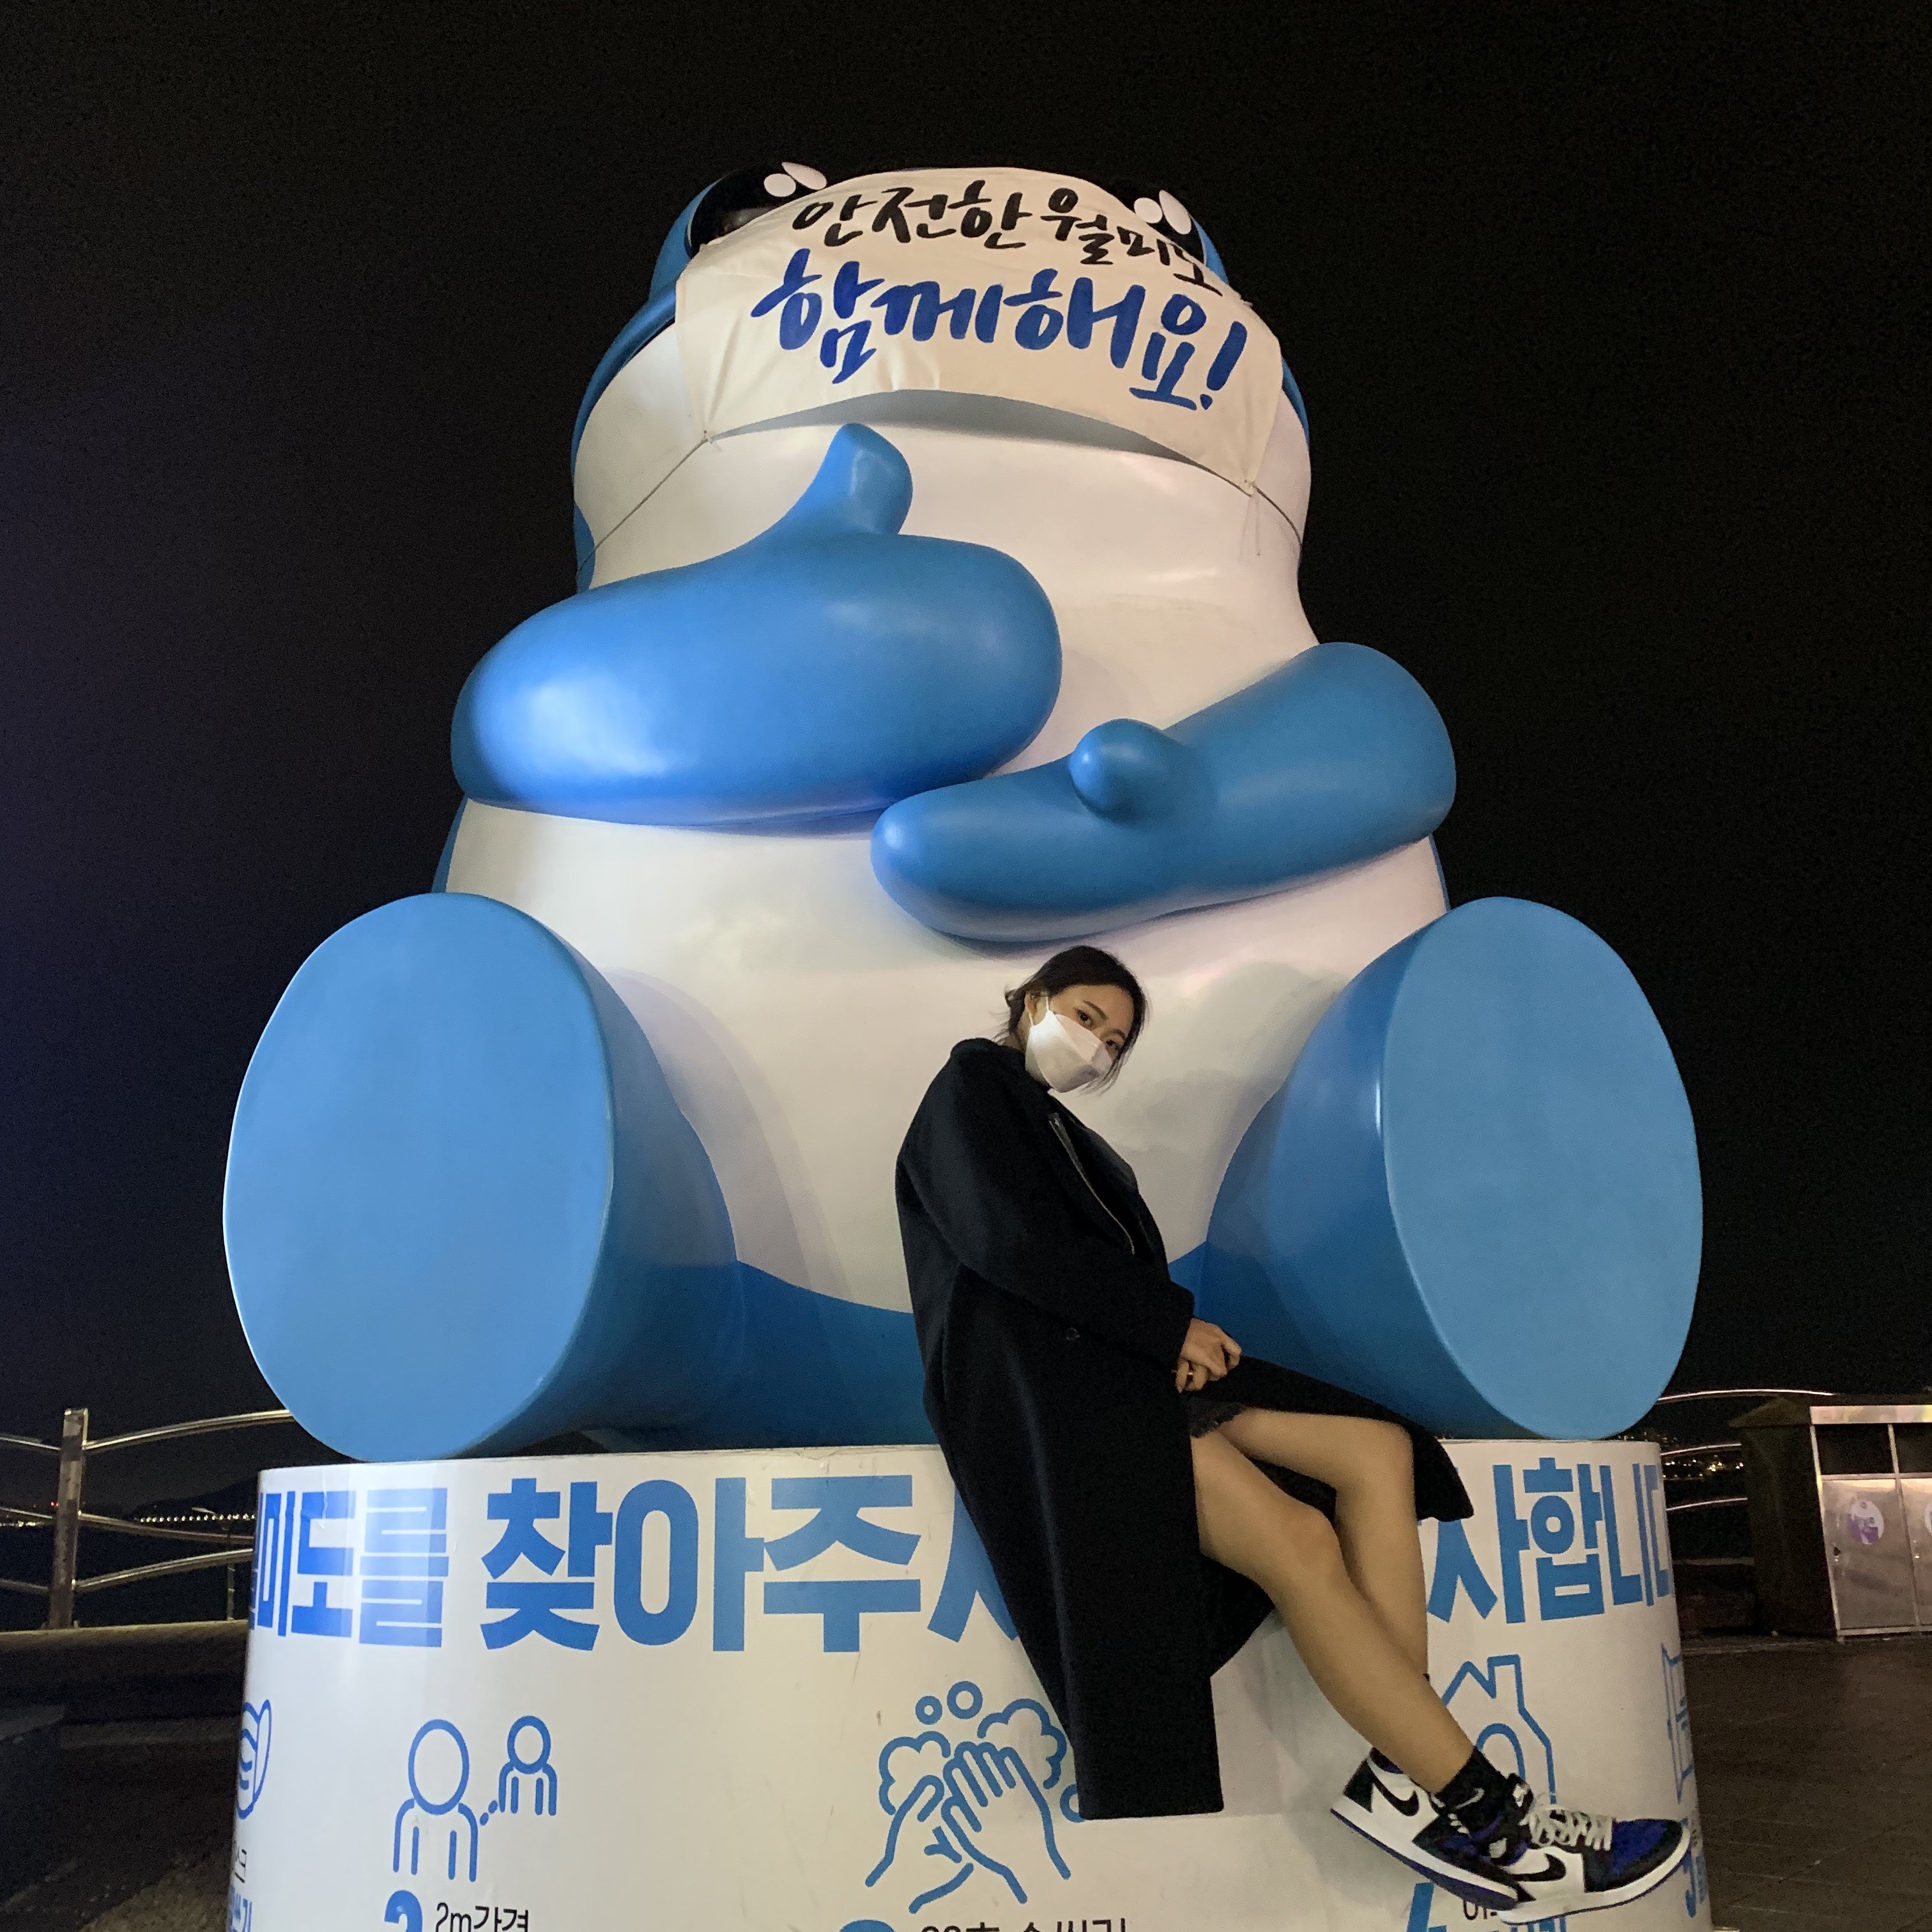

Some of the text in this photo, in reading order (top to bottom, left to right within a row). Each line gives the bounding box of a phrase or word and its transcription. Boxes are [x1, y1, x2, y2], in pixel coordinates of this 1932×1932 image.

[792, 179, 1223, 297] 안전한 월미도
[249, 1487, 450, 1648] 미도를
